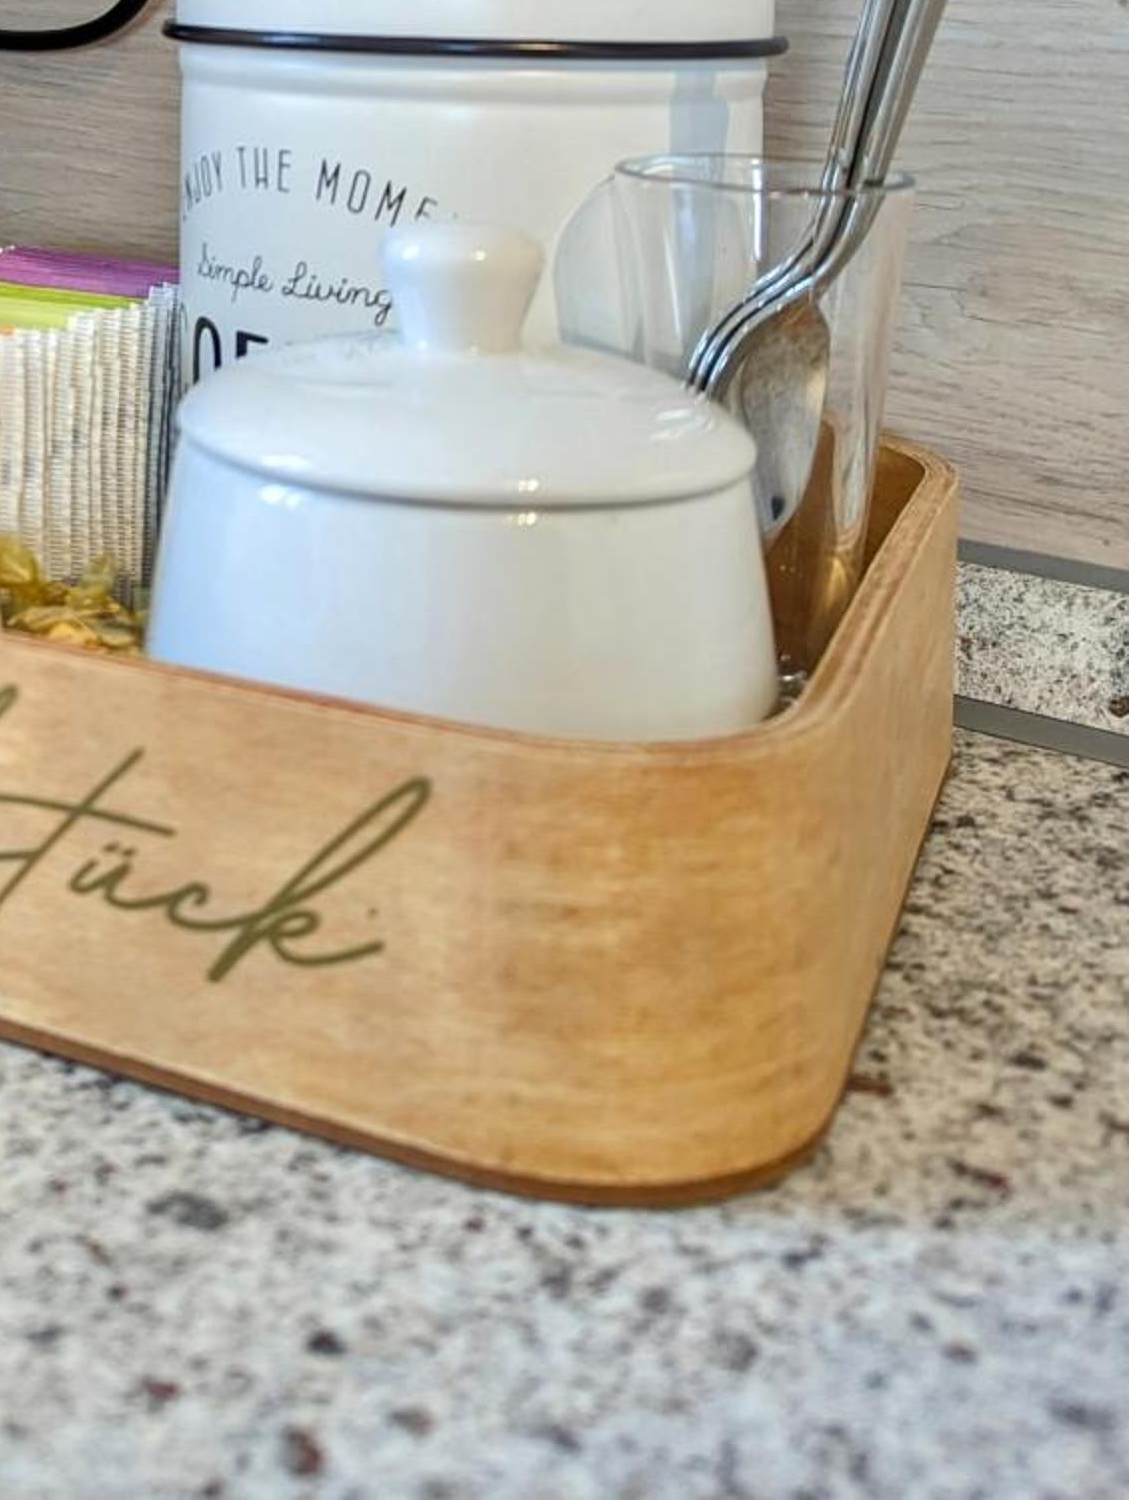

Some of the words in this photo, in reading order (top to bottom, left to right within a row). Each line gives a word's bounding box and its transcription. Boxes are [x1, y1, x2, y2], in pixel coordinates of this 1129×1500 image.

[182, 151, 223, 222] NJOY
[236, 146, 292, 193] THE
[315, 158, 441, 228] MOME
[197, 242, 273, 303] Simple
[282, 261, 393, 326] Living
